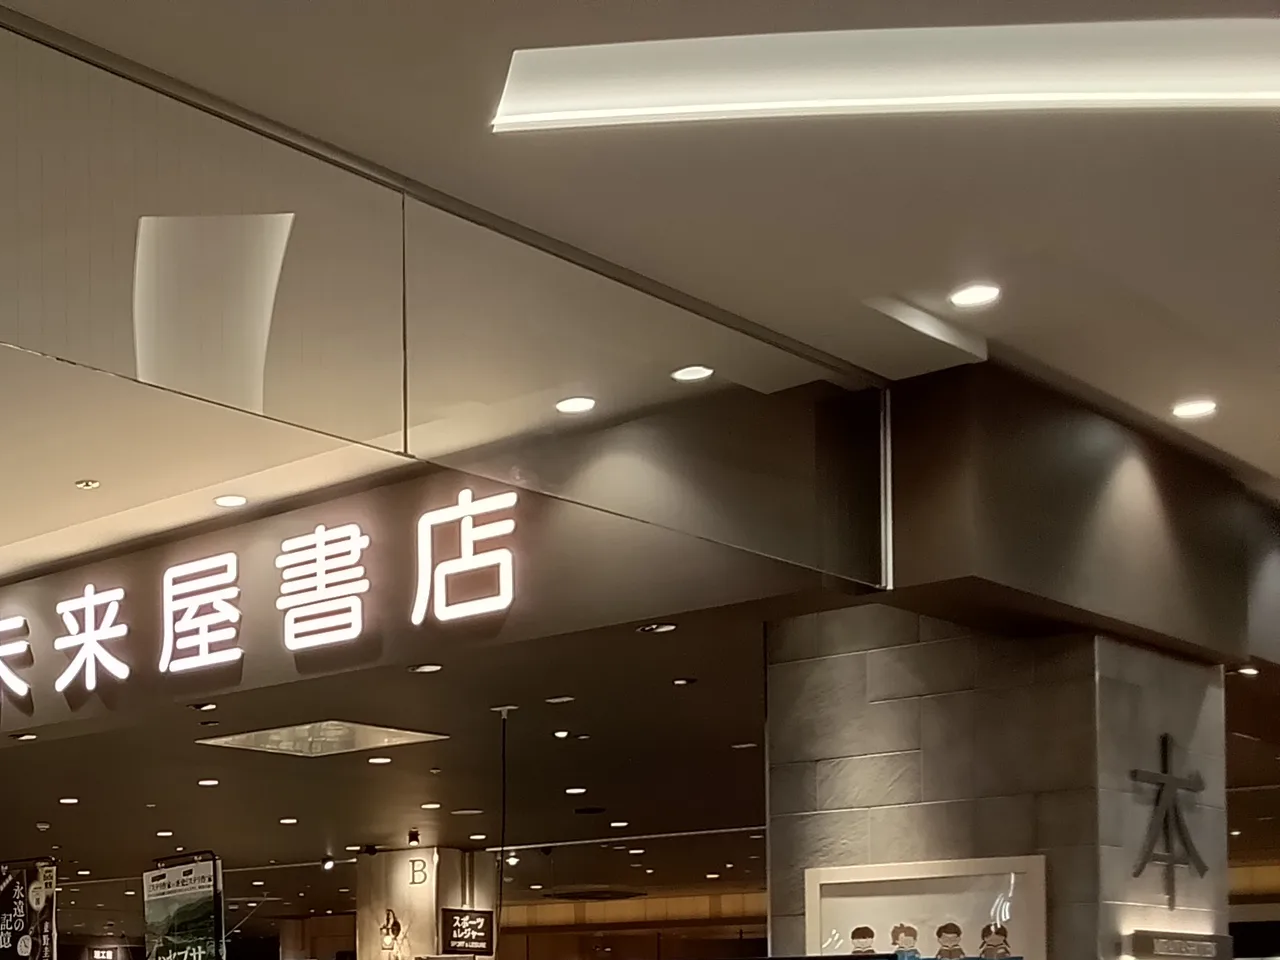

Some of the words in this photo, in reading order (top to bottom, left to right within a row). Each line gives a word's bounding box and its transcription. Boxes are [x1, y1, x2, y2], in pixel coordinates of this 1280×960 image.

[408, 858, 428, 886] B
[12, 881, 26, 932] 永遠の
[452, 915, 485, 929] スポーツ
